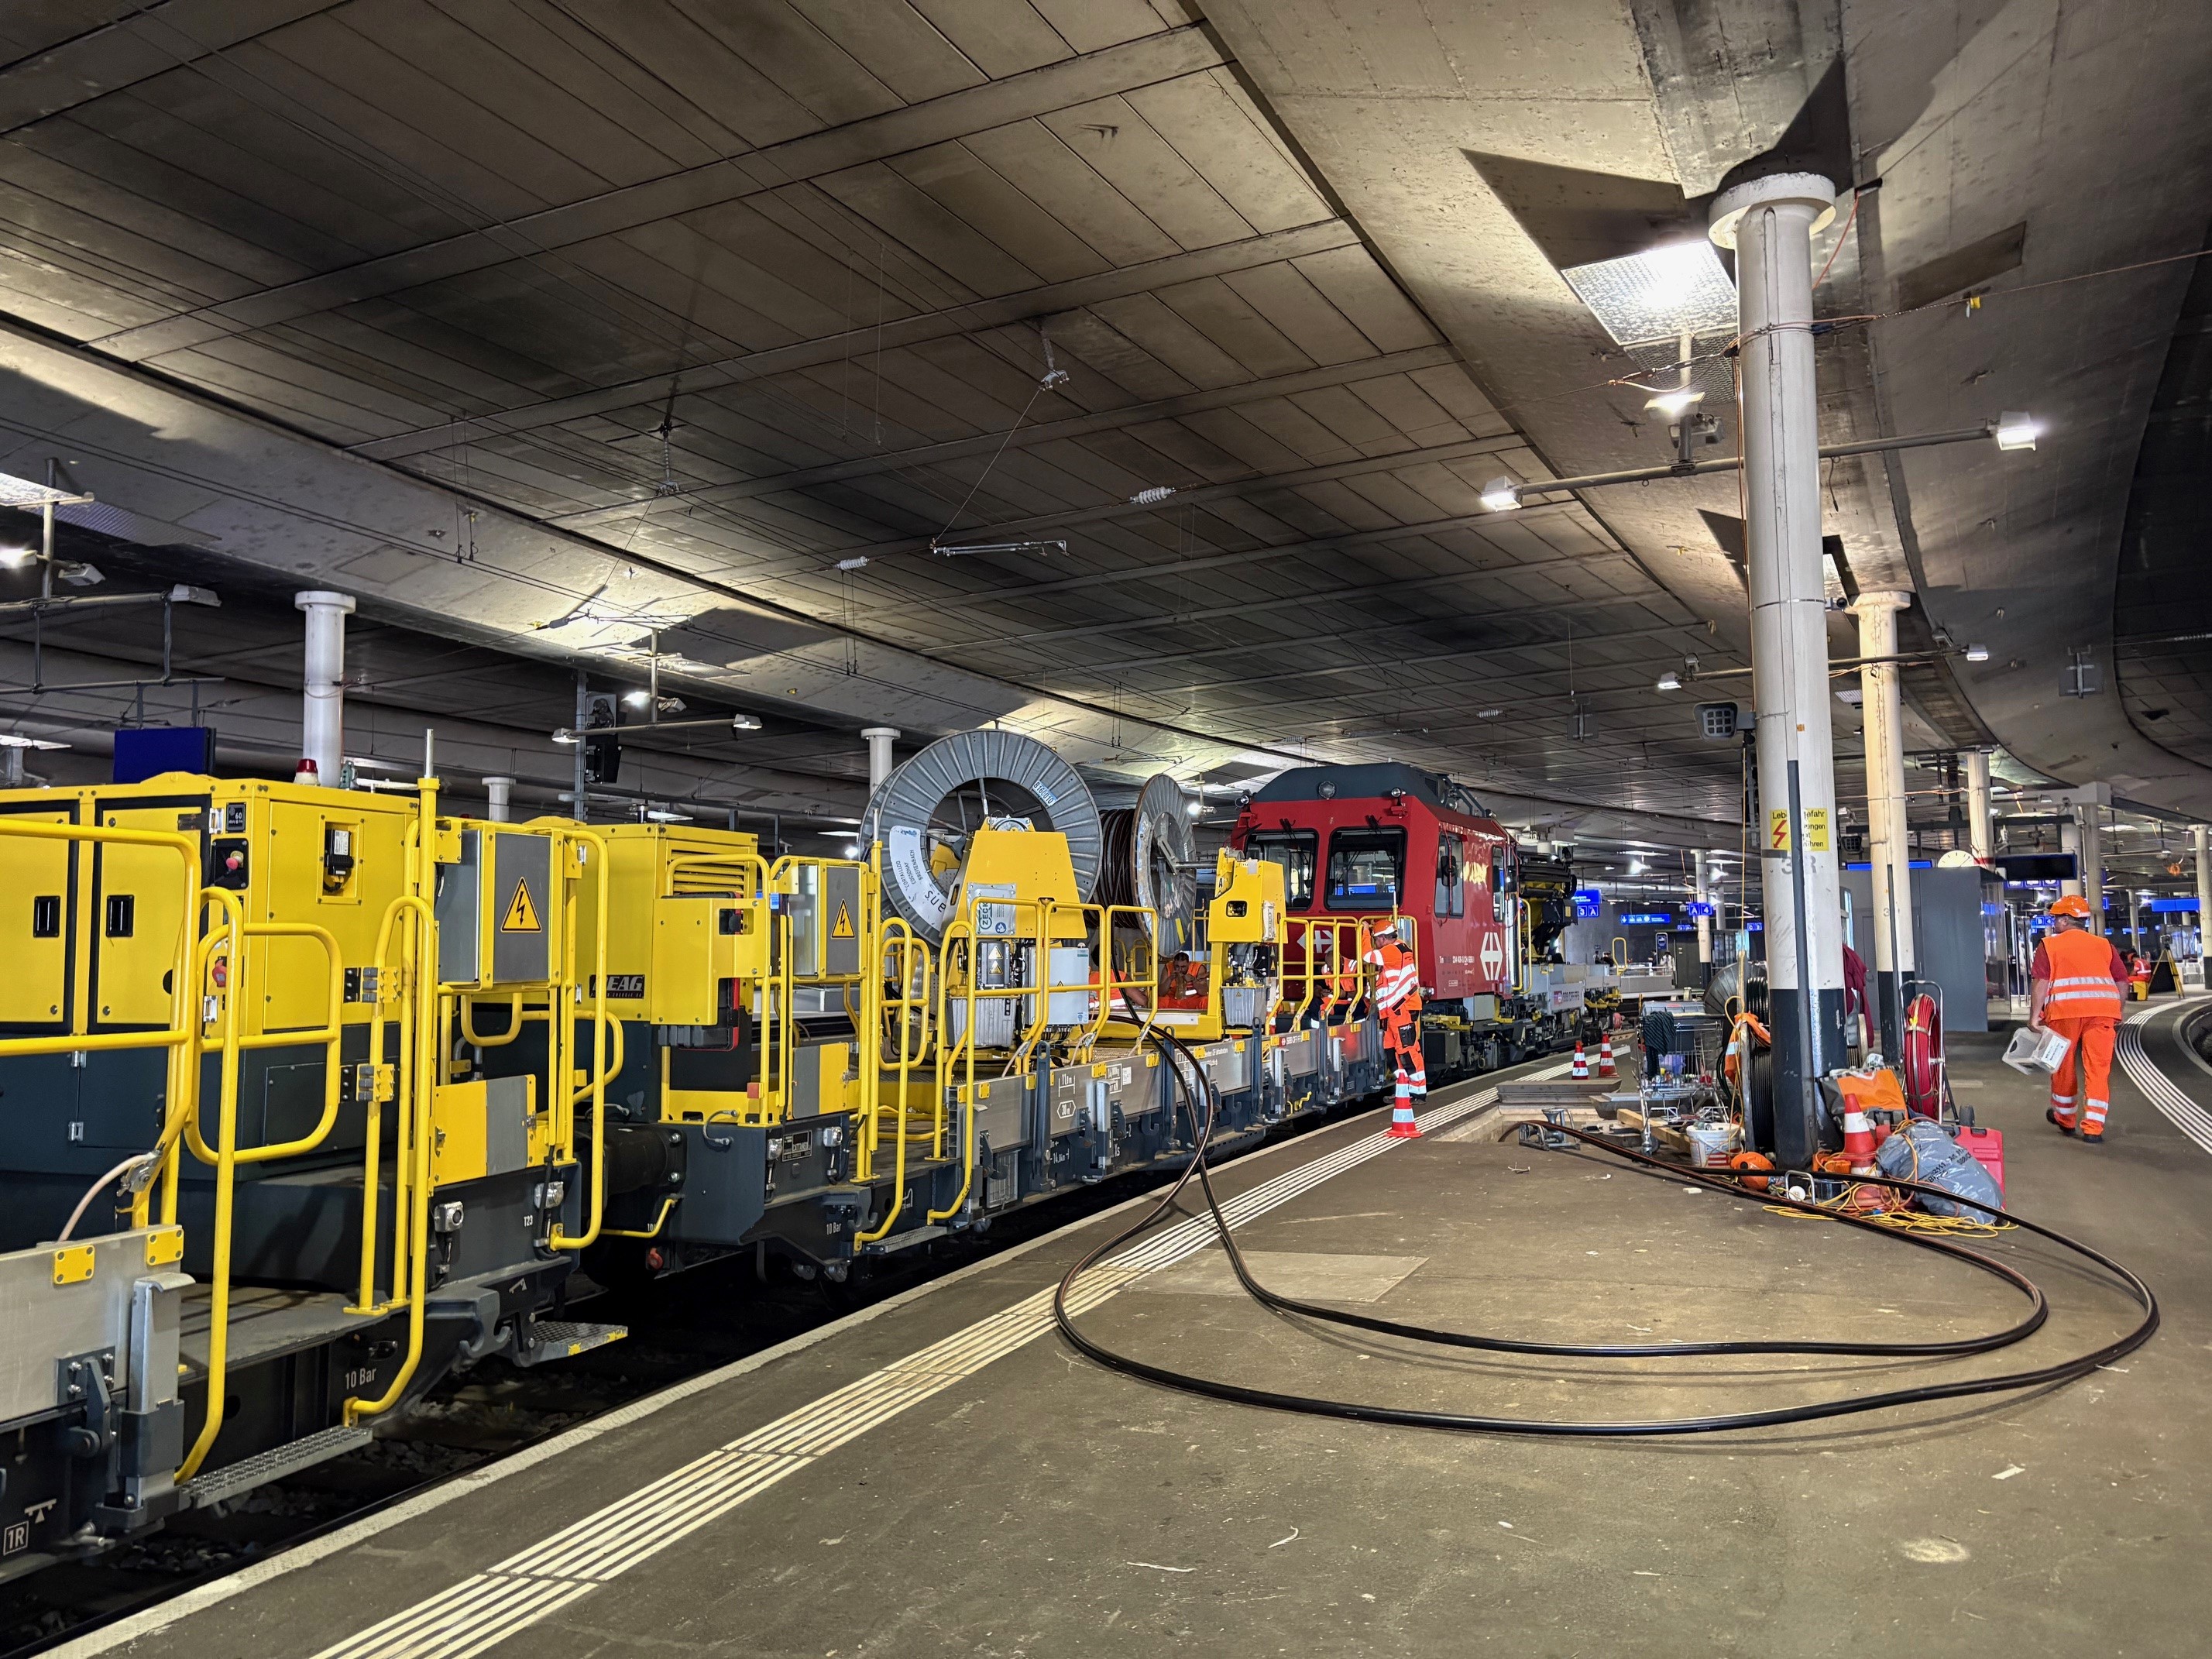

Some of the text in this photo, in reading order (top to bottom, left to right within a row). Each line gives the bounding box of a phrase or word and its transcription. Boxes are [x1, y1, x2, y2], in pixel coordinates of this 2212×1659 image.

[1772, 809, 1825, 819] Lebefahr
[592, 976, 644, 991] EAG
[523, 1214, 534, 1228] T23
[826, 1221, 842, 1235] 10 Bar
[345, 1367, 377, 1390] 10 Bar
[7, 1527, 26, 1550] 1R
